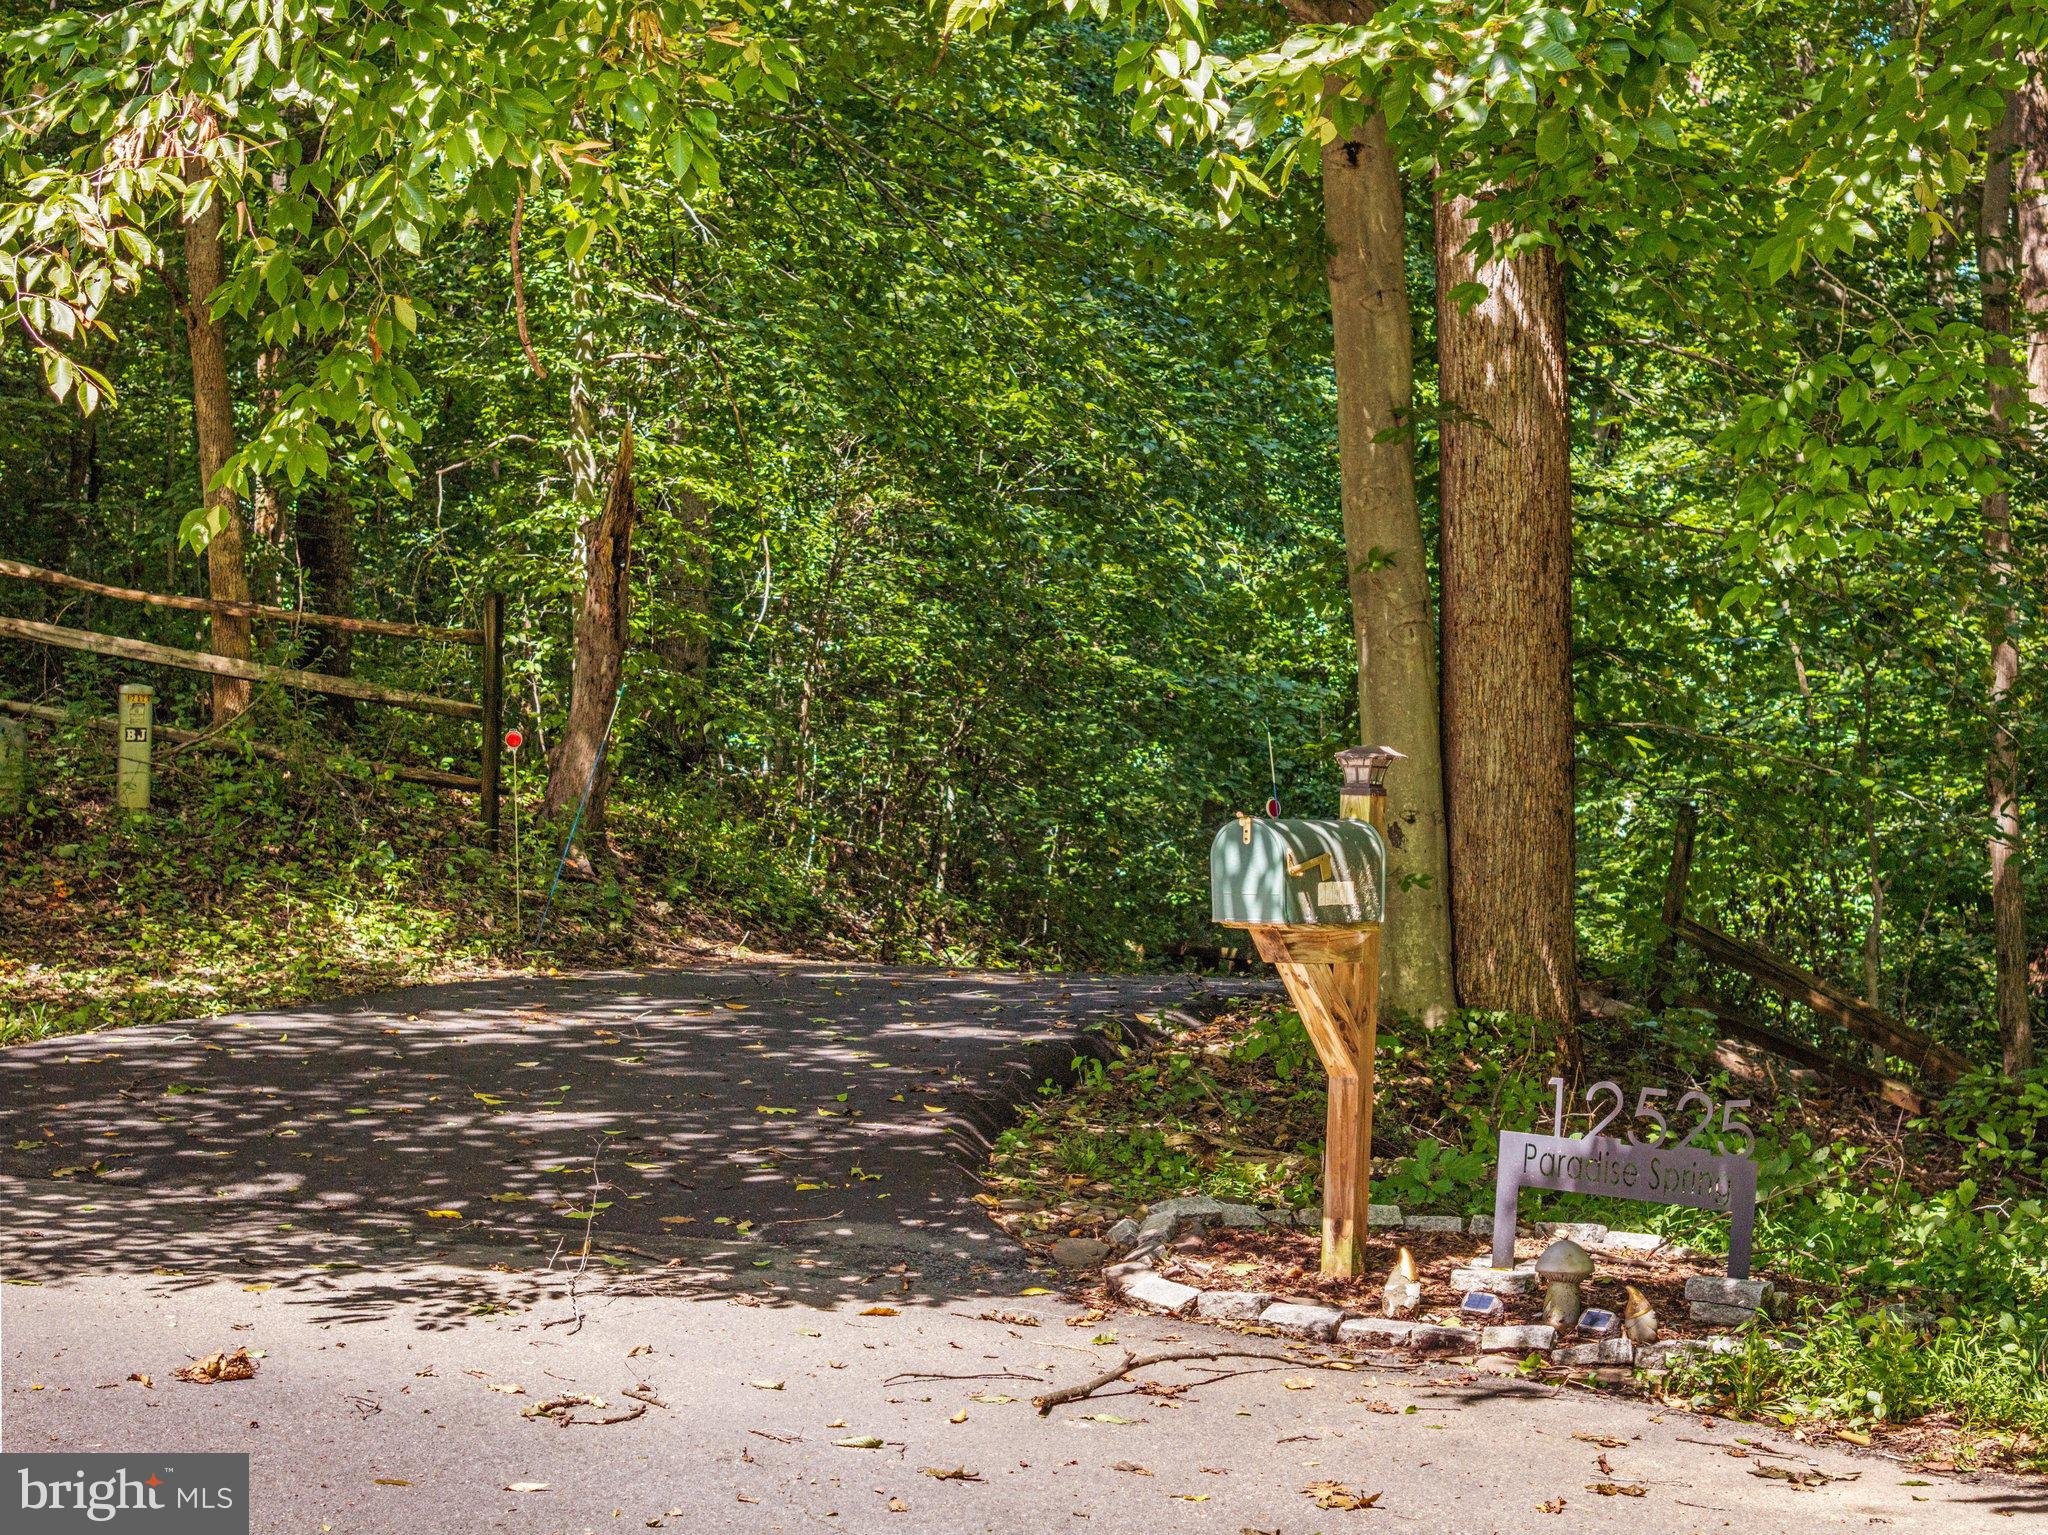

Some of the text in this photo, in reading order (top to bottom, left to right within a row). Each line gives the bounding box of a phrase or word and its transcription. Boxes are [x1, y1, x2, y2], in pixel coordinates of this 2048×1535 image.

[126, 729, 147, 741] BJ
[1548, 1077, 1755, 1159] 12525
[1523, 1142, 1732, 1207] Paradise Spring
